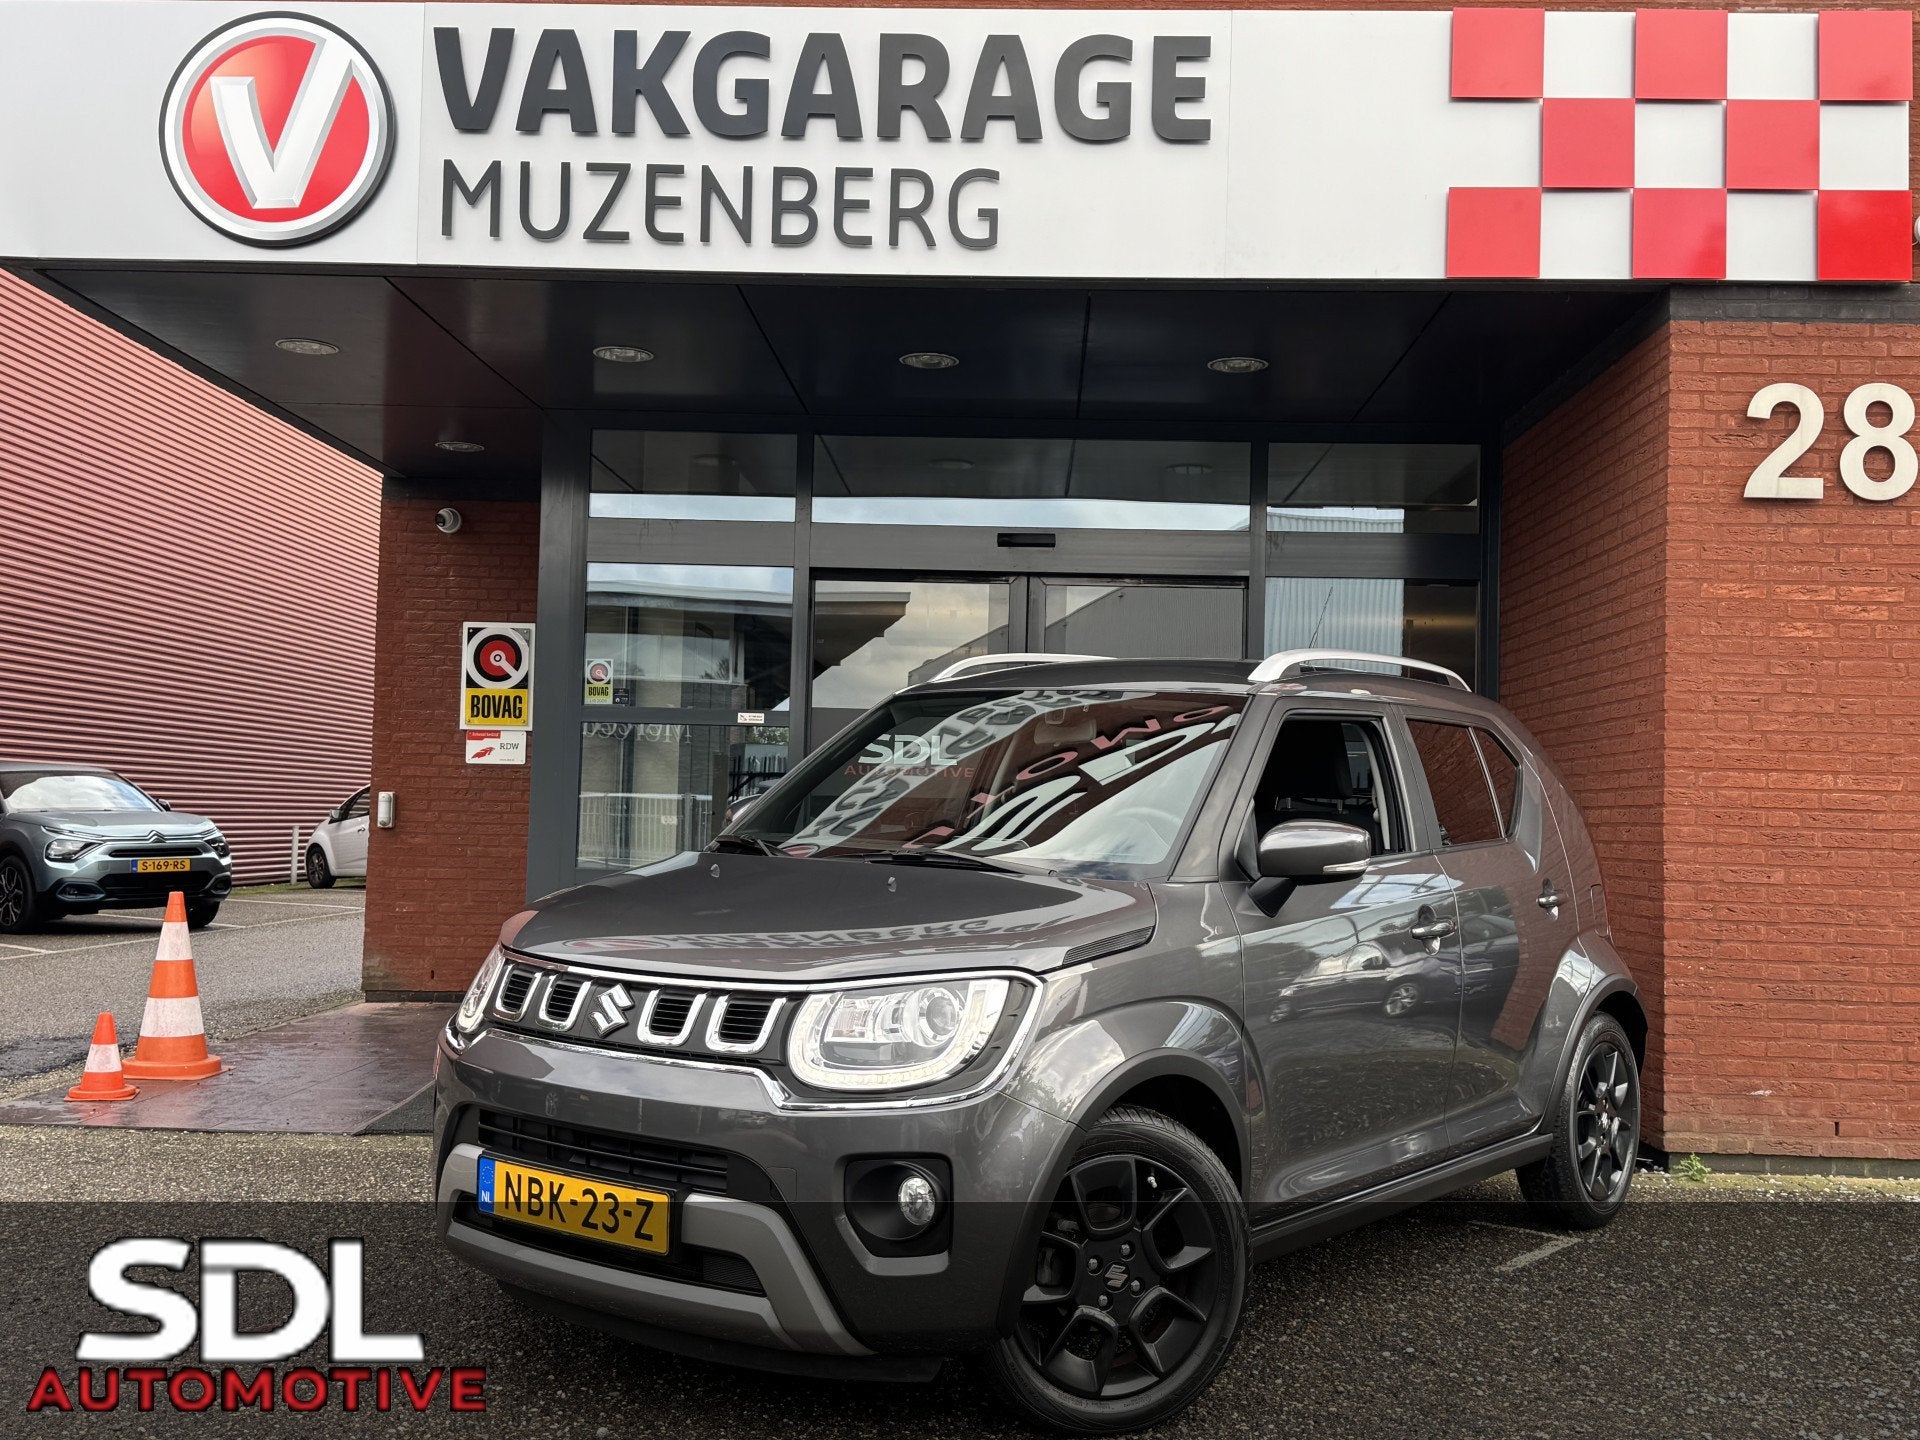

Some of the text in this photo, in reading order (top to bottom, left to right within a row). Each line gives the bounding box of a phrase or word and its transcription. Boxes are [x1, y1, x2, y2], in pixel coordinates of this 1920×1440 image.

[433, 27, 1212, 145] VAKGARAGE
[441, 158, 1000, 249] MUZENBERG
[1743, 382, 1919, 501] 28
[588, 686, 609, 697] BOVAG
[470, 694, 523, 719] BOVAG
[499, 742, 520, 750] RDW
[858, 733, 958, 766] SDL
[844, 765, 977, 778] AUTOMOTIVE
[141, 860, 186, 871] S-169-RS
[481, 1189, 492, 1203] NL
[504, 1170, 654, 1242] NBK-23-Z
